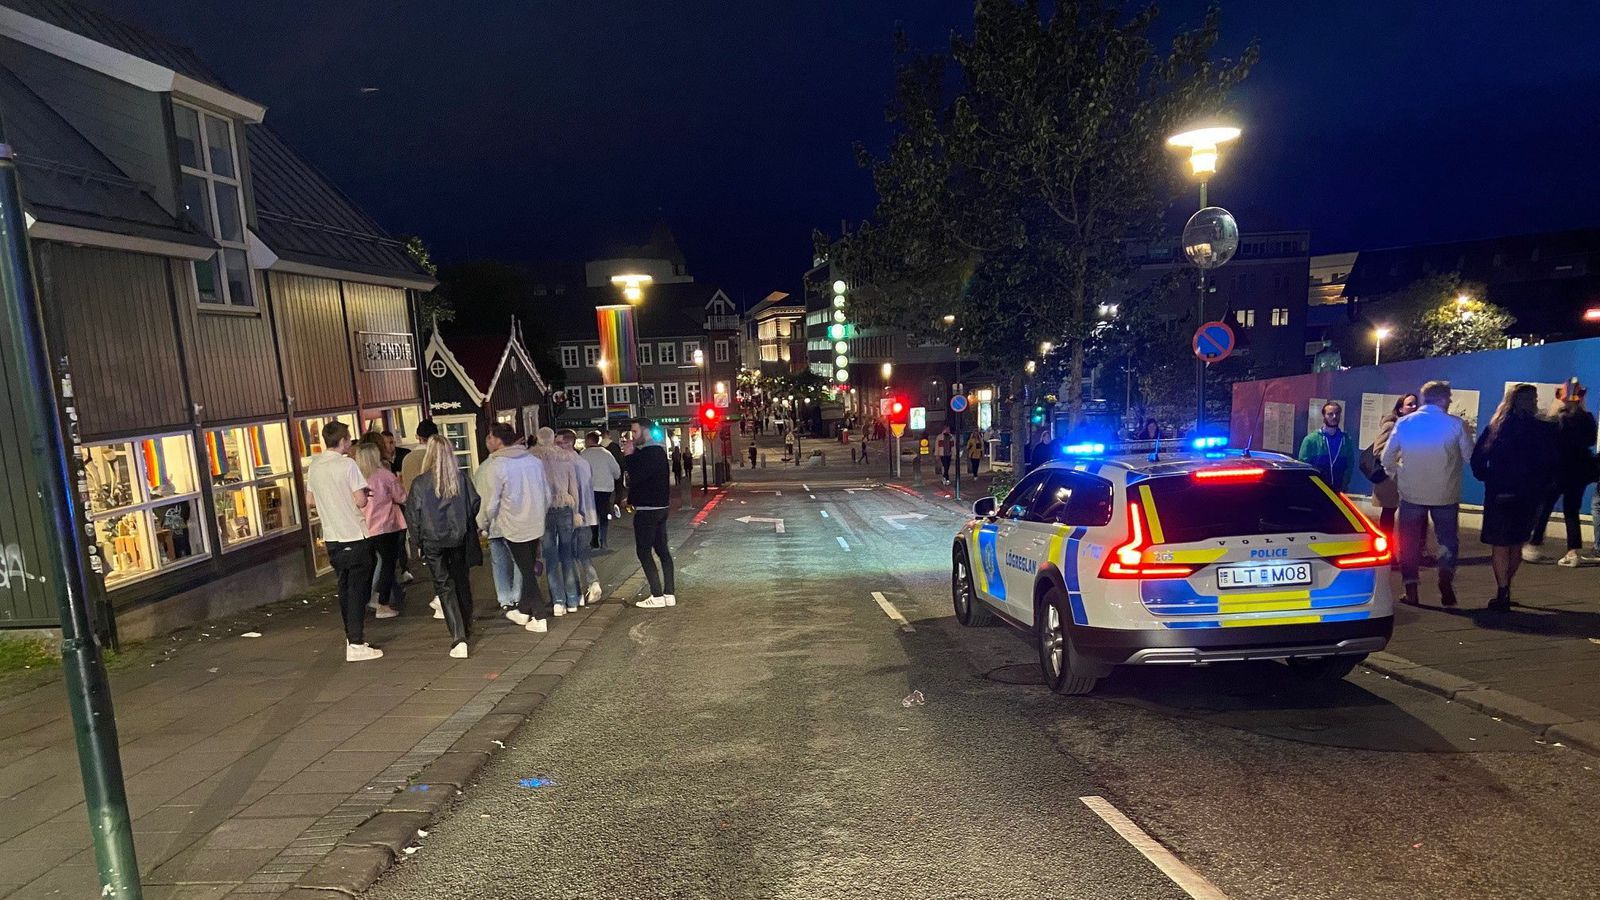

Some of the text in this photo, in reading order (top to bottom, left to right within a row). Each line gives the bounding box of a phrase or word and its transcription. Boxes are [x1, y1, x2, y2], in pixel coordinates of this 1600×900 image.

[1217, 536, 1317, 547] VOLVO
[1250, 548, 1288, 558] POLICE
[1006, 549, 1037, 574] LÖGREGLAN
[1232, 566, 1307, 583] LT M08
